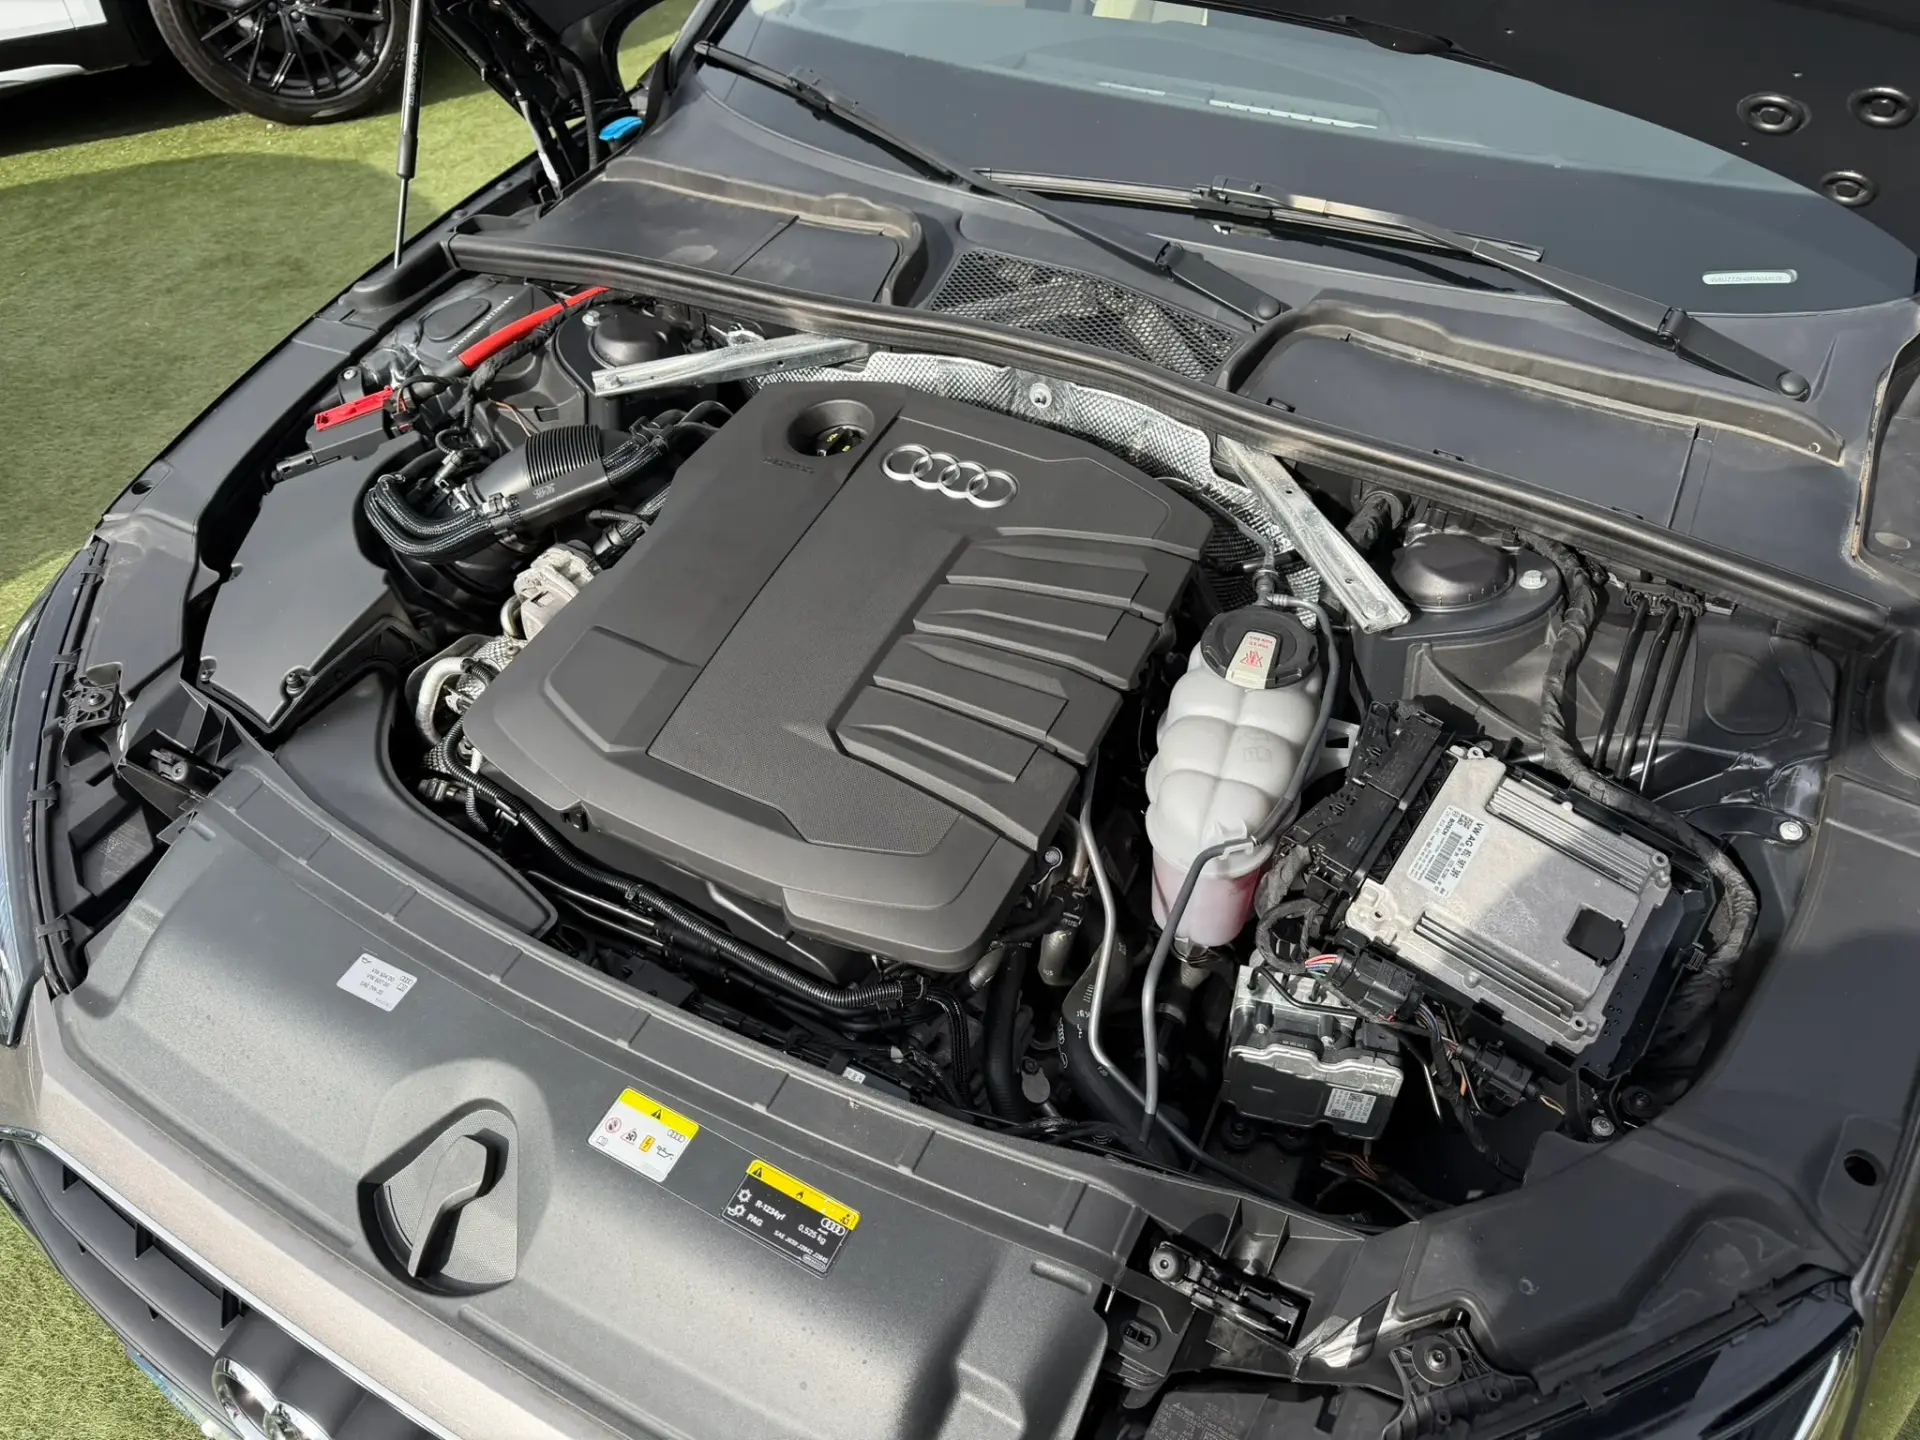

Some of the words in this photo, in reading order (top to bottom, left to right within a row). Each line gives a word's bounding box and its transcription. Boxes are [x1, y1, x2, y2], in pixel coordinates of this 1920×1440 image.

[1472, 822, 1485, 836] VW
[1465, 834, 1477, 848] AG
[755, 1199, 787, 1221] R-1234yf
[746, 1213, 764, 1227] PAG
[797, 1223, 818, 1240] 0,525
[816, 1233, 827, 1245] kg
